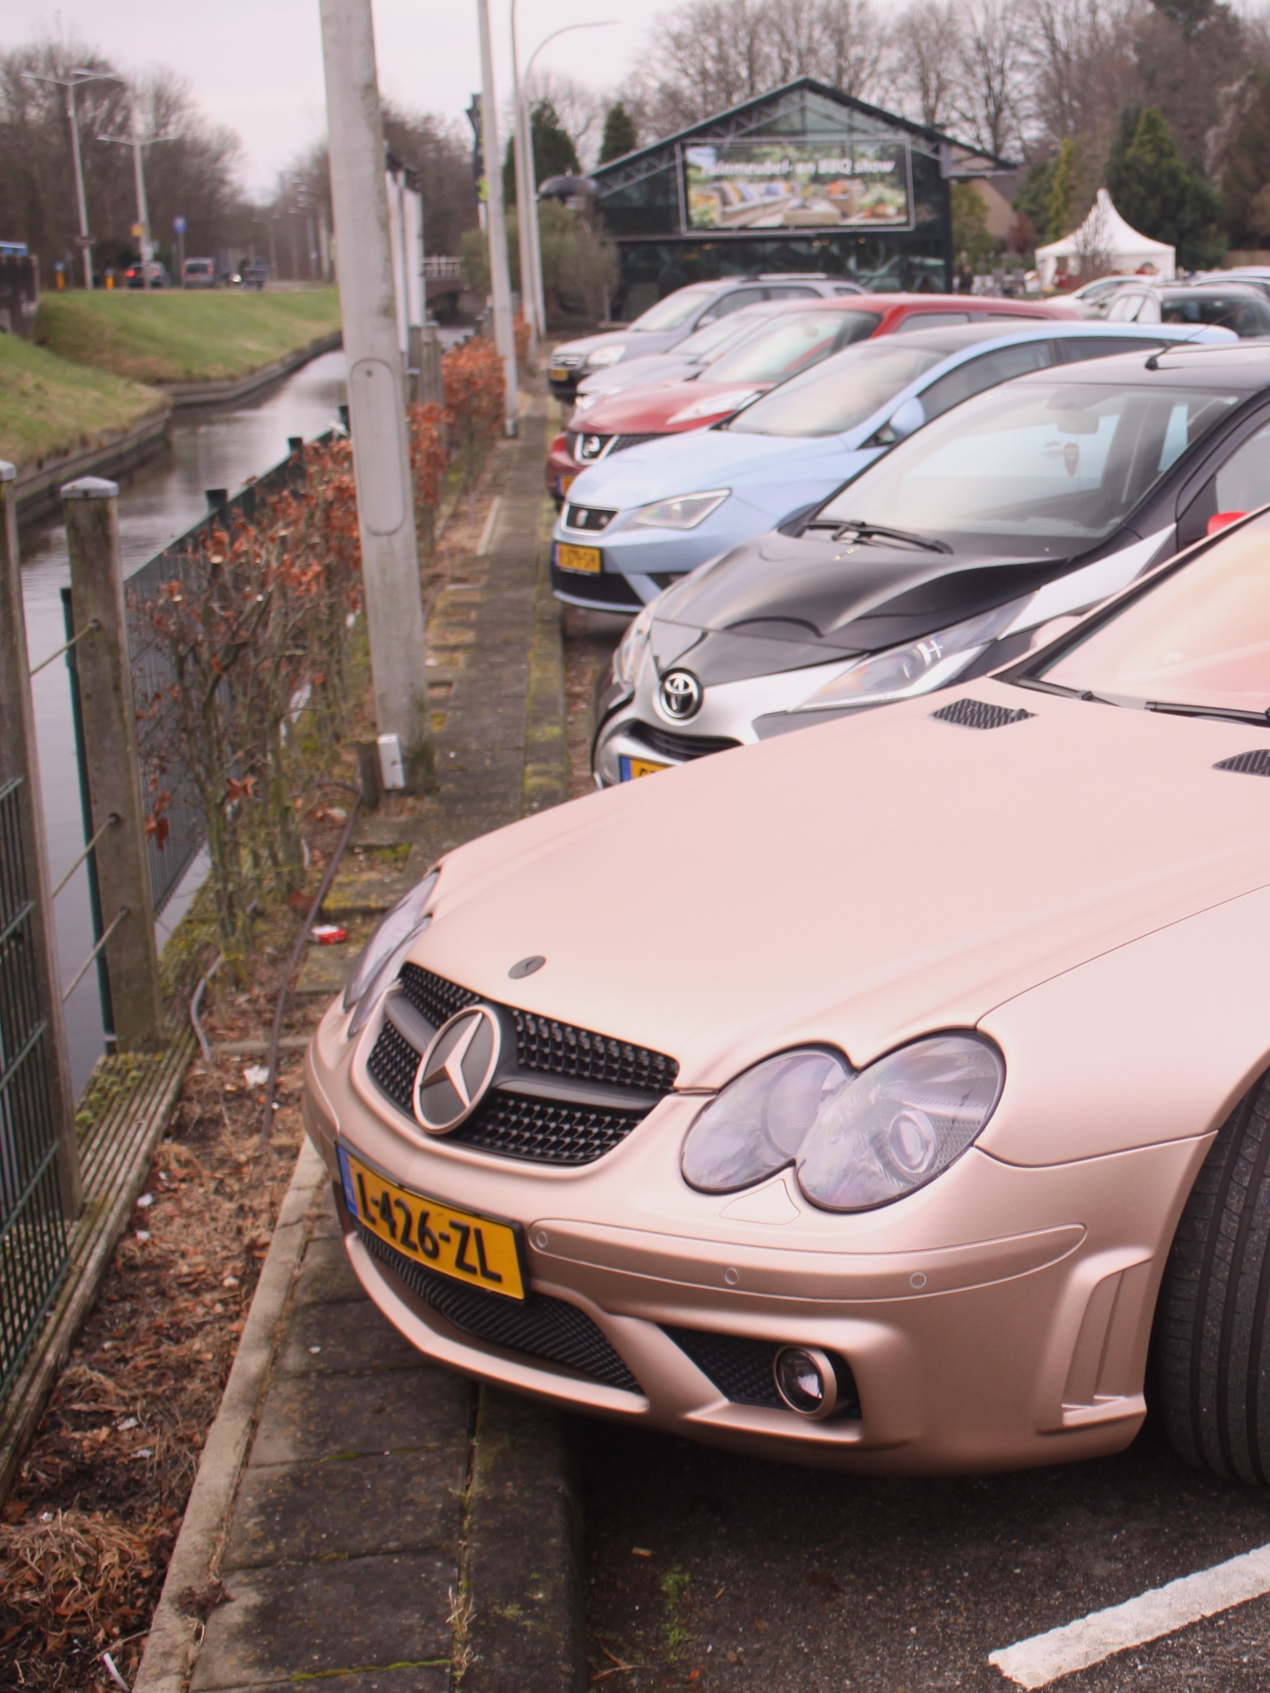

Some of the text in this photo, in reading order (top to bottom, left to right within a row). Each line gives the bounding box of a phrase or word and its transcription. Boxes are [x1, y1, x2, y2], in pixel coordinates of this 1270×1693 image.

[818, 158, 852, 175] BBQ
[854, 159, 895, 174] show
[356, 1172, 503, 1283] L-426-ZL
